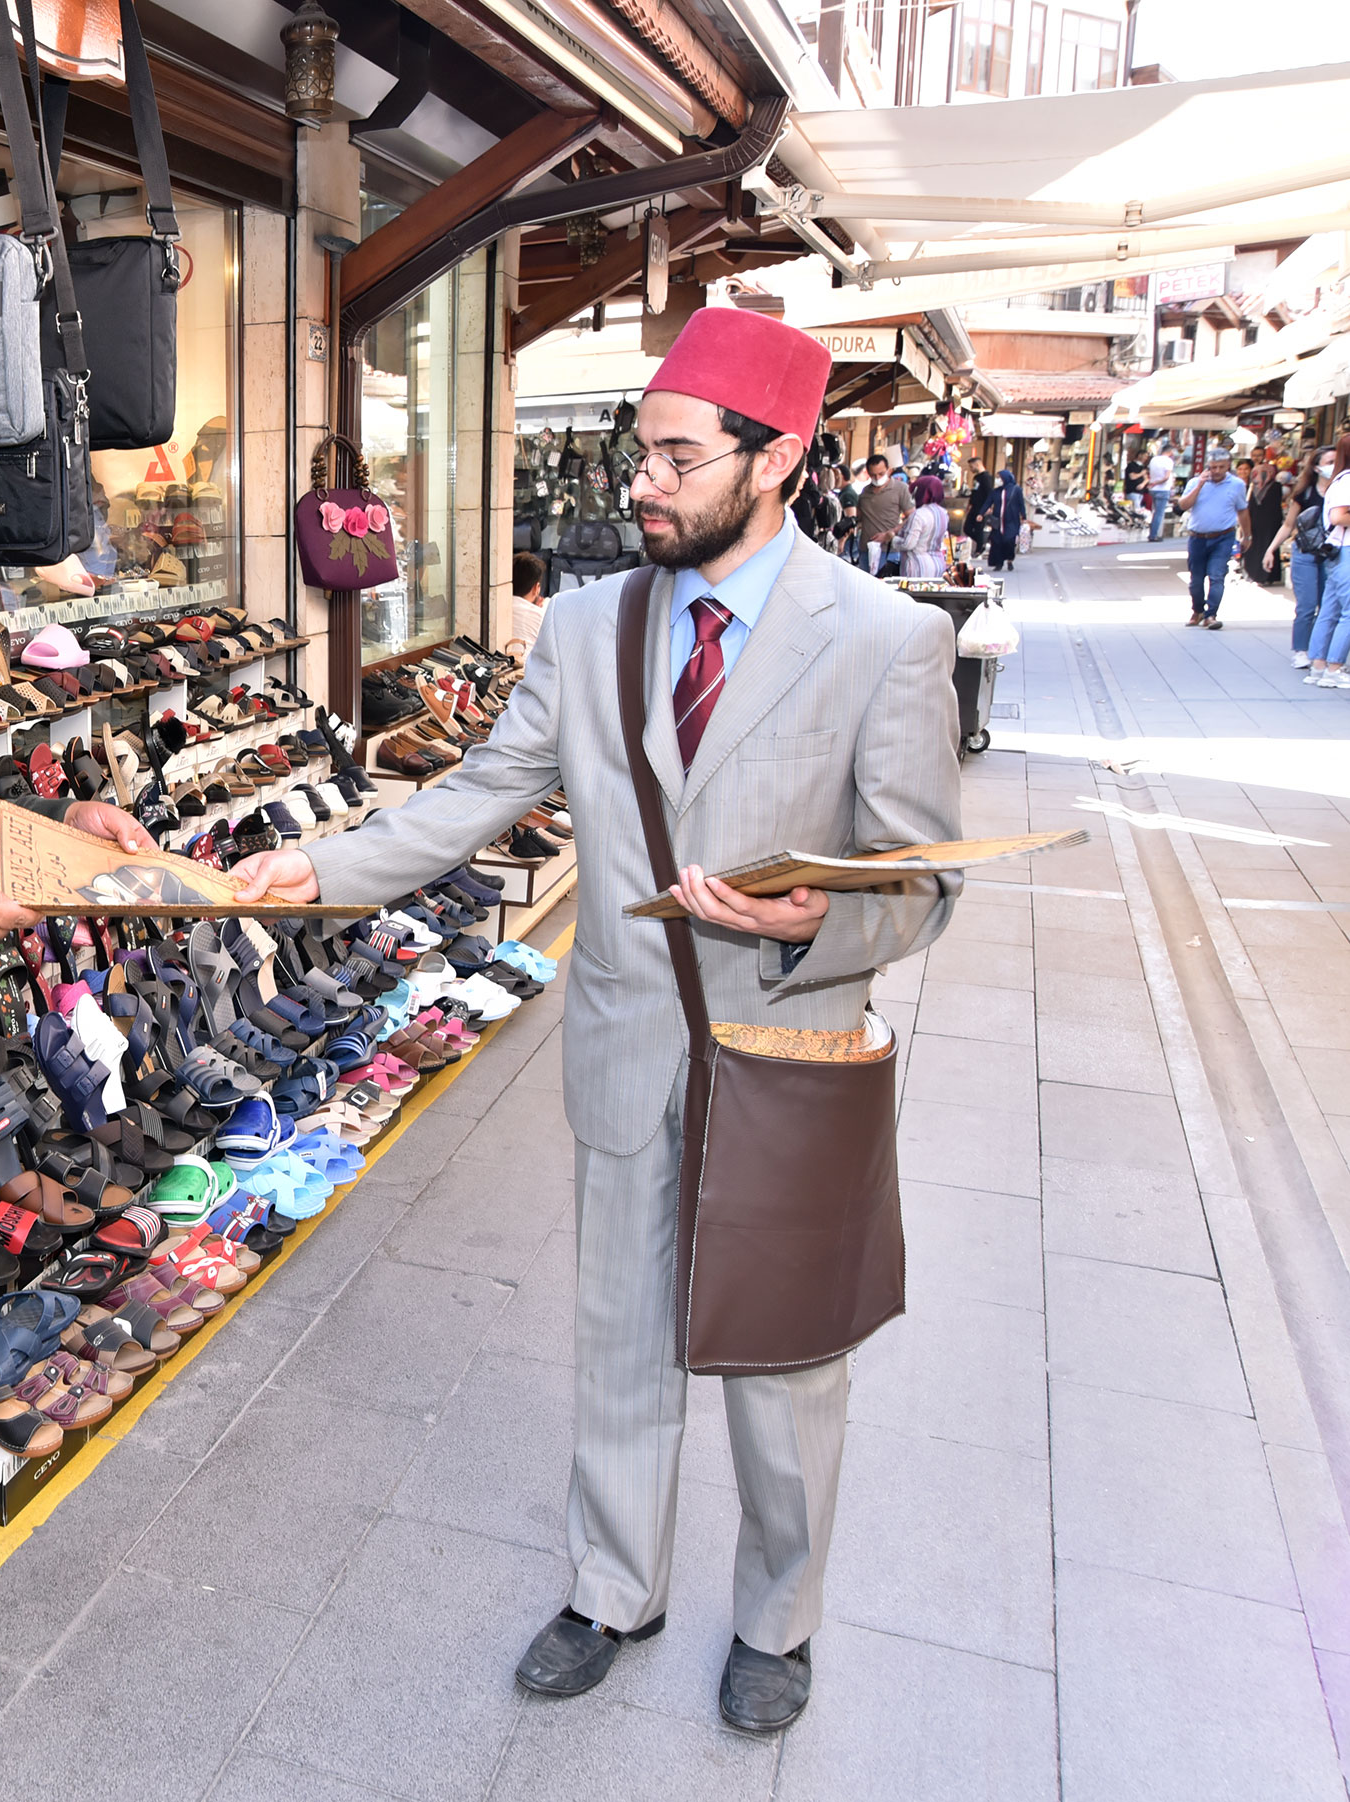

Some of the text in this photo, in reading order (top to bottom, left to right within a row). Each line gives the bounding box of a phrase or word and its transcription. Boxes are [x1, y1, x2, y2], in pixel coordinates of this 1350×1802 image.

[1159, 274, 1221, 294] PETEK
[314, 336, 322, 350] 22
[815, 336, 876, 353] NDURA
[9, 637, 26, 647] EYO
[33, 1450, 61, 1481] CEYO
